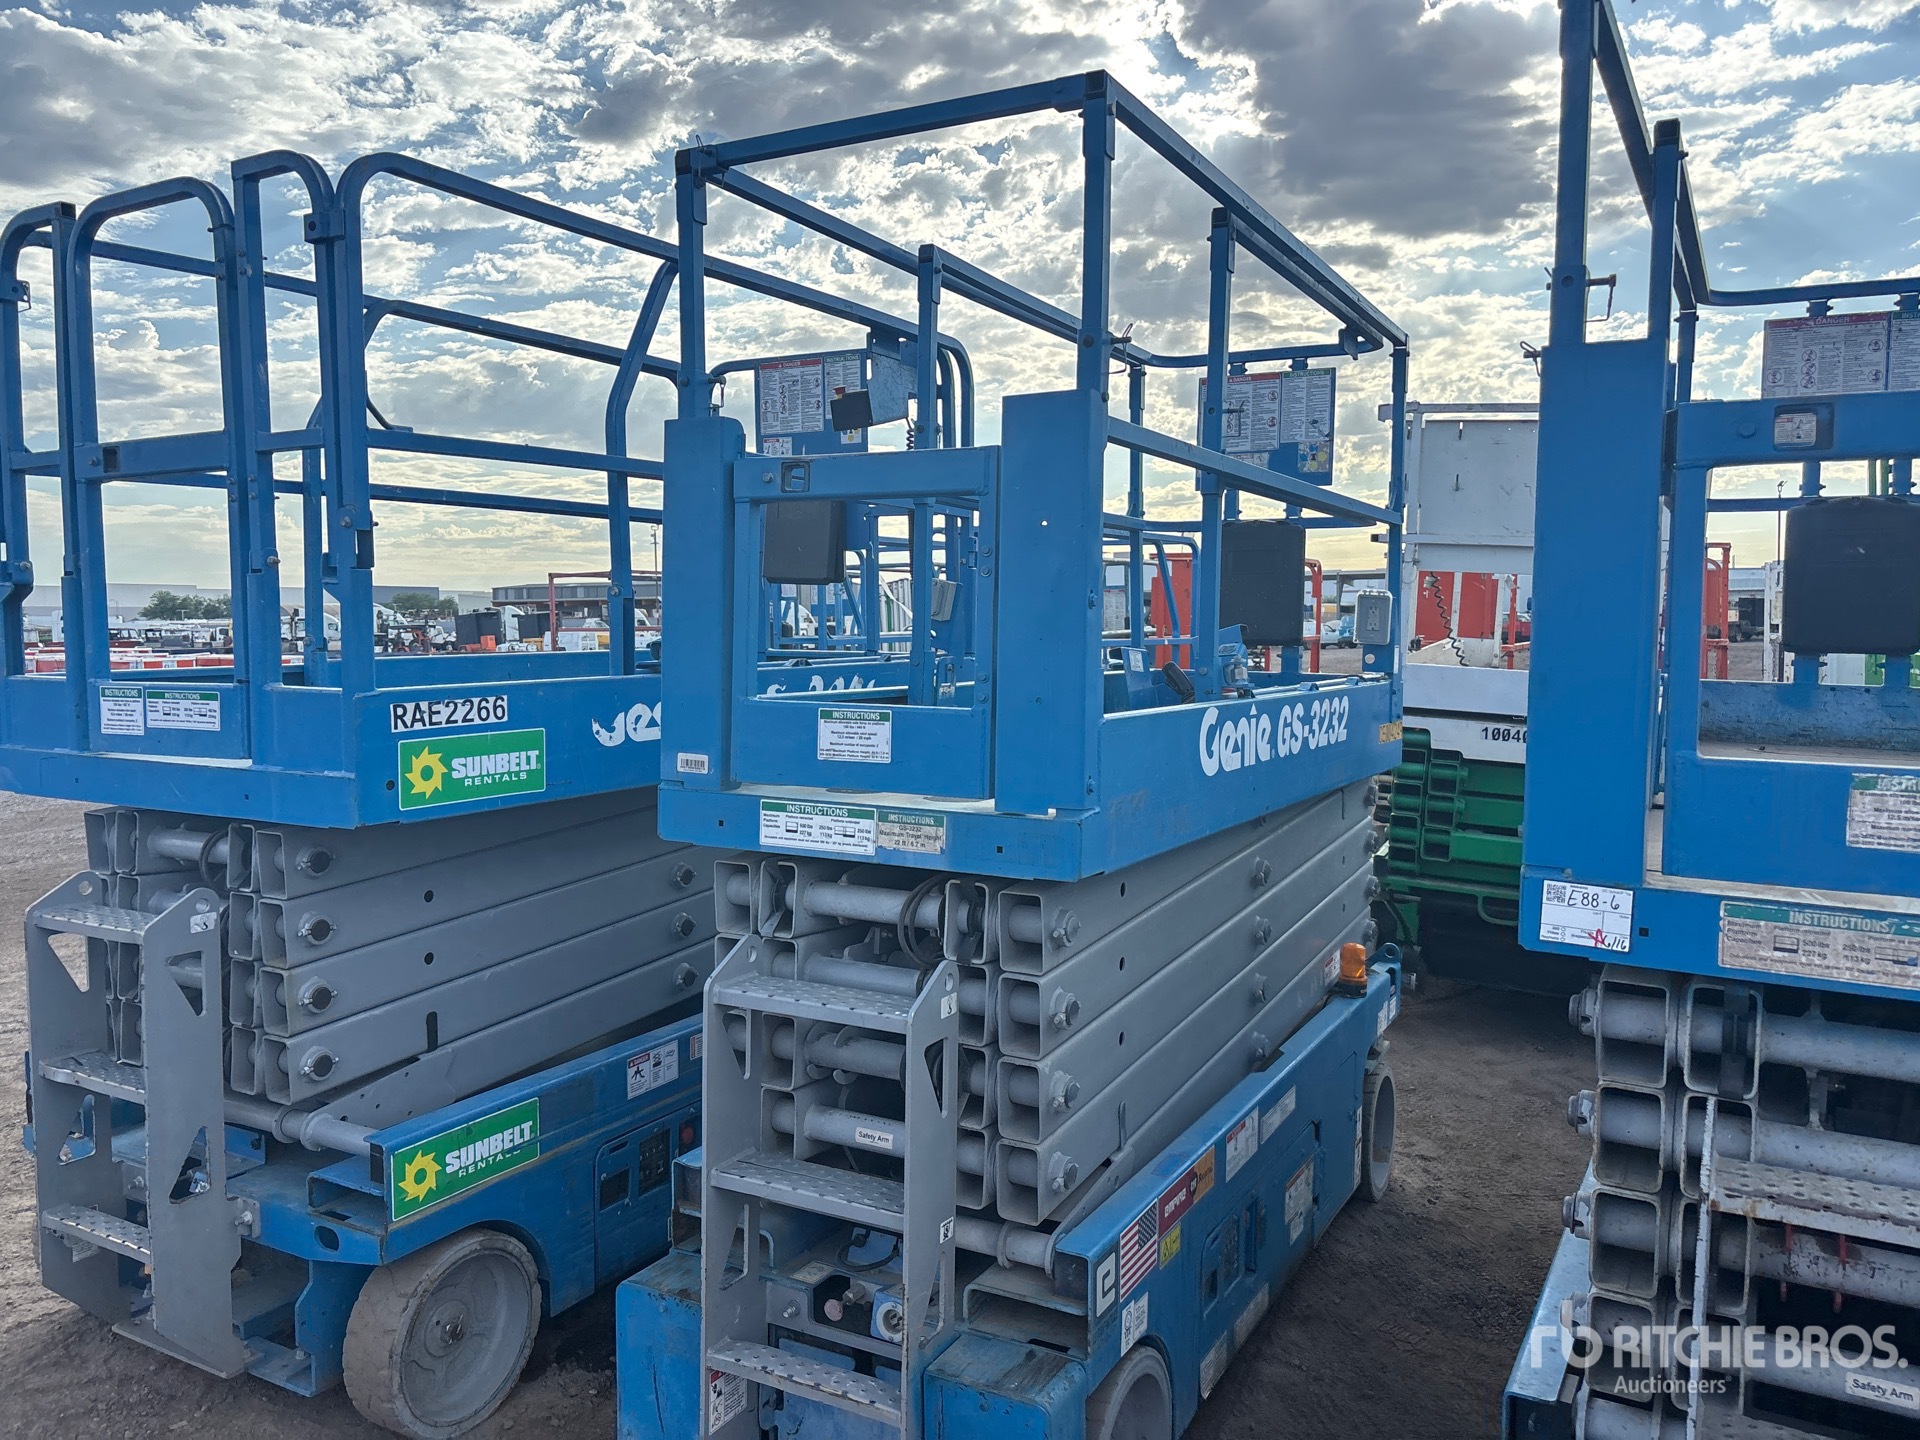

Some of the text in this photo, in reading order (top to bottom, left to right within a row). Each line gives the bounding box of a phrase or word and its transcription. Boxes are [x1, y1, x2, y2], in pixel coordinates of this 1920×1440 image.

[1815, 316, 1850, 325] DANGER
[826, 354, 859, 363] INSTRUCTIONS
[104, 688, 139, 697] INSTRUCTIONS
[164, 692, 200, 700] INSTRUCTIONS
[392, 696, 506, 731] RAE2266
[832, 711, 880, 720] INSTRUCTIONS
[1200, 695, 1349, 777] Genie GS-3232
[451, 749, 540, 779] SUNBELT
[464, 771, 528, 787] RENTALS
[786, 804, 849, 817] INSTRUCTIONS
[888, 813, 935, 825] INSTRUCTIONS
[1788, 910, 1890, 933] INSTRUCTIONS
[858, 1130, 890, 1144] Safety Arm
[445, 1121, 533, 1174] SUNBELT
[1852, 1378, 1914, 1402] Safety Arm
